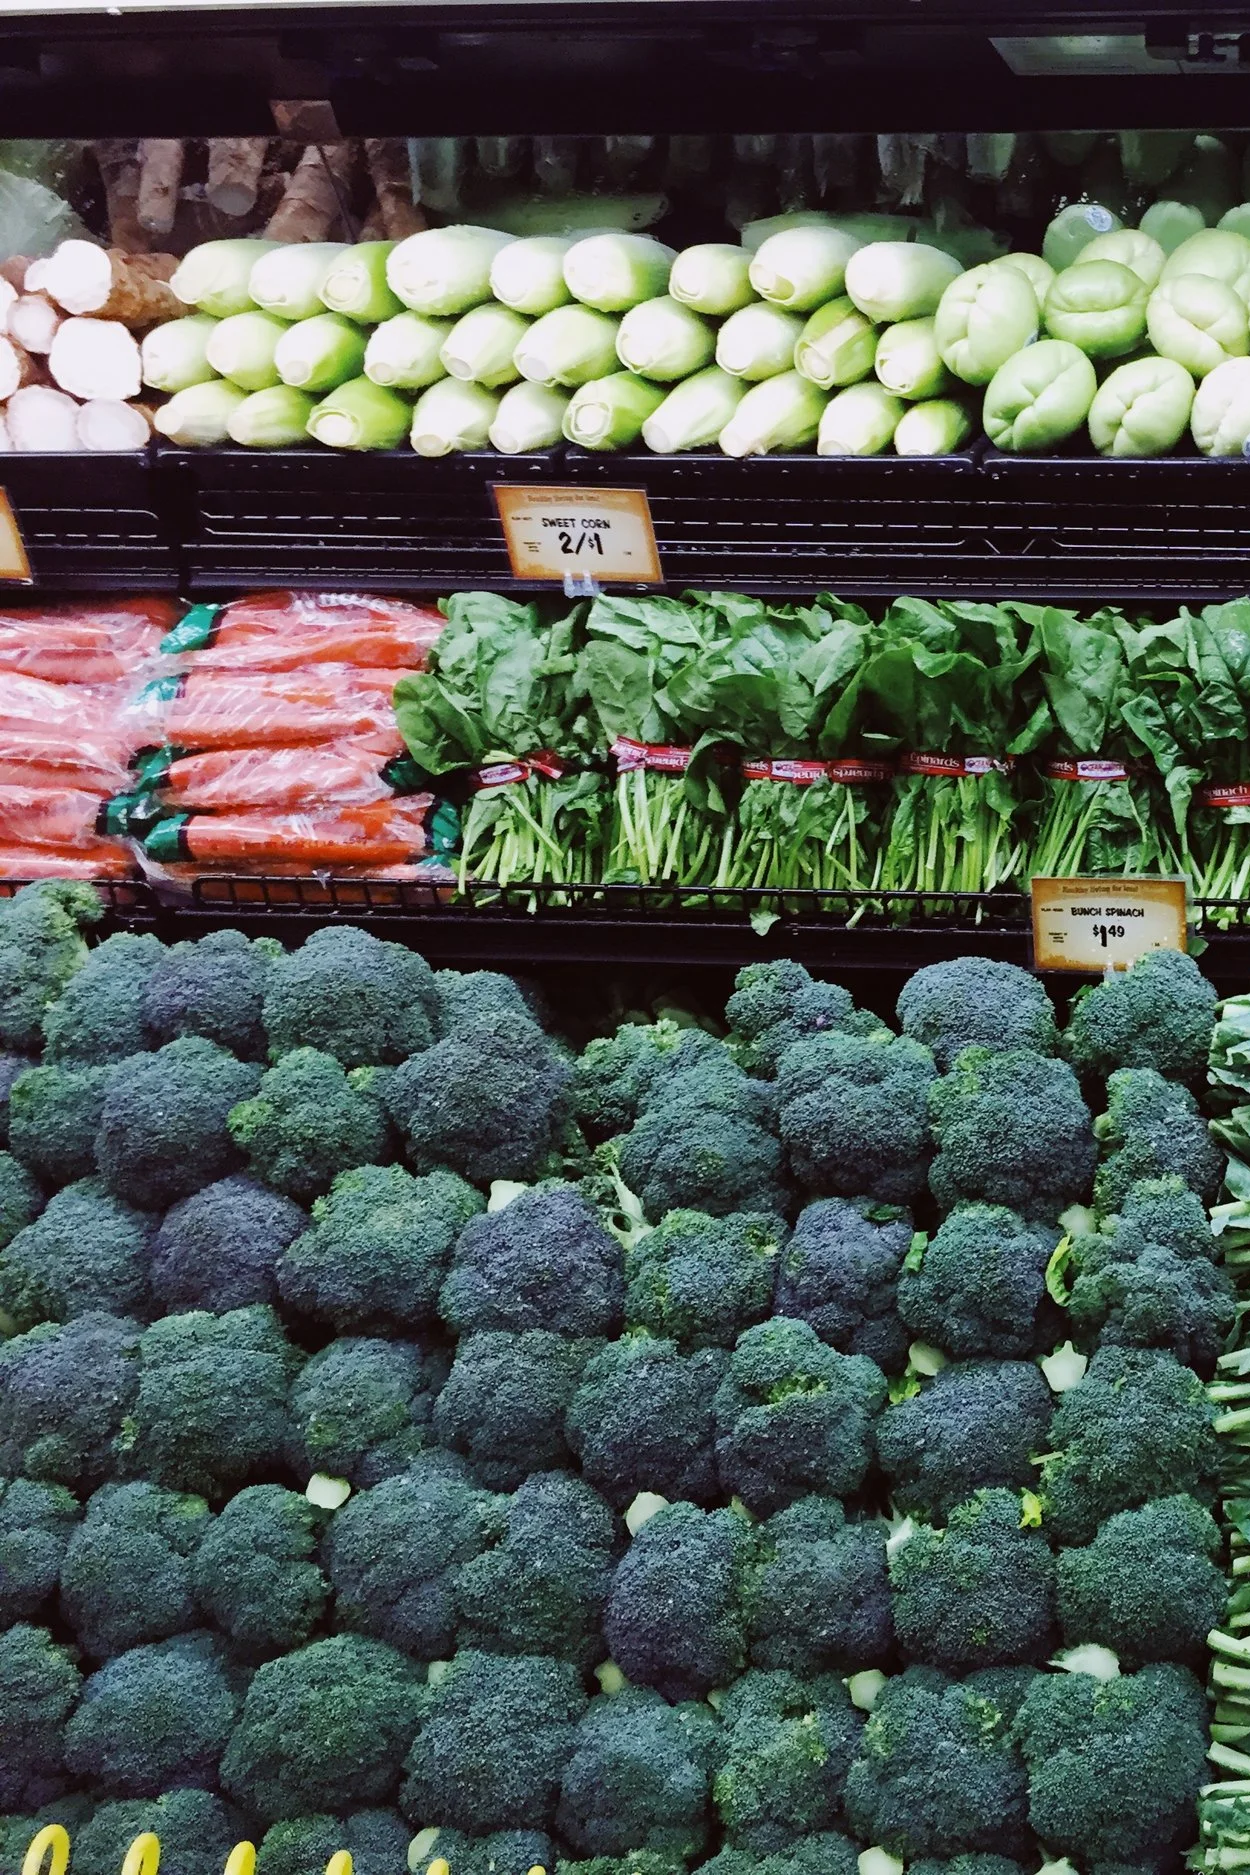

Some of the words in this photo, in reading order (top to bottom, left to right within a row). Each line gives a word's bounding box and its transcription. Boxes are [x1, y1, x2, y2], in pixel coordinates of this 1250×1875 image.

[542, 518, 576, 528] SWEET
[581, 519, 611, 529] CORN
[558, 532, 604, 555] 2/$1
[1202, 785, 1248, 798] Spinach
[1071, 908, 1102, 916] BUNCH
[1105, 908, 1144, 917] SPINACH
